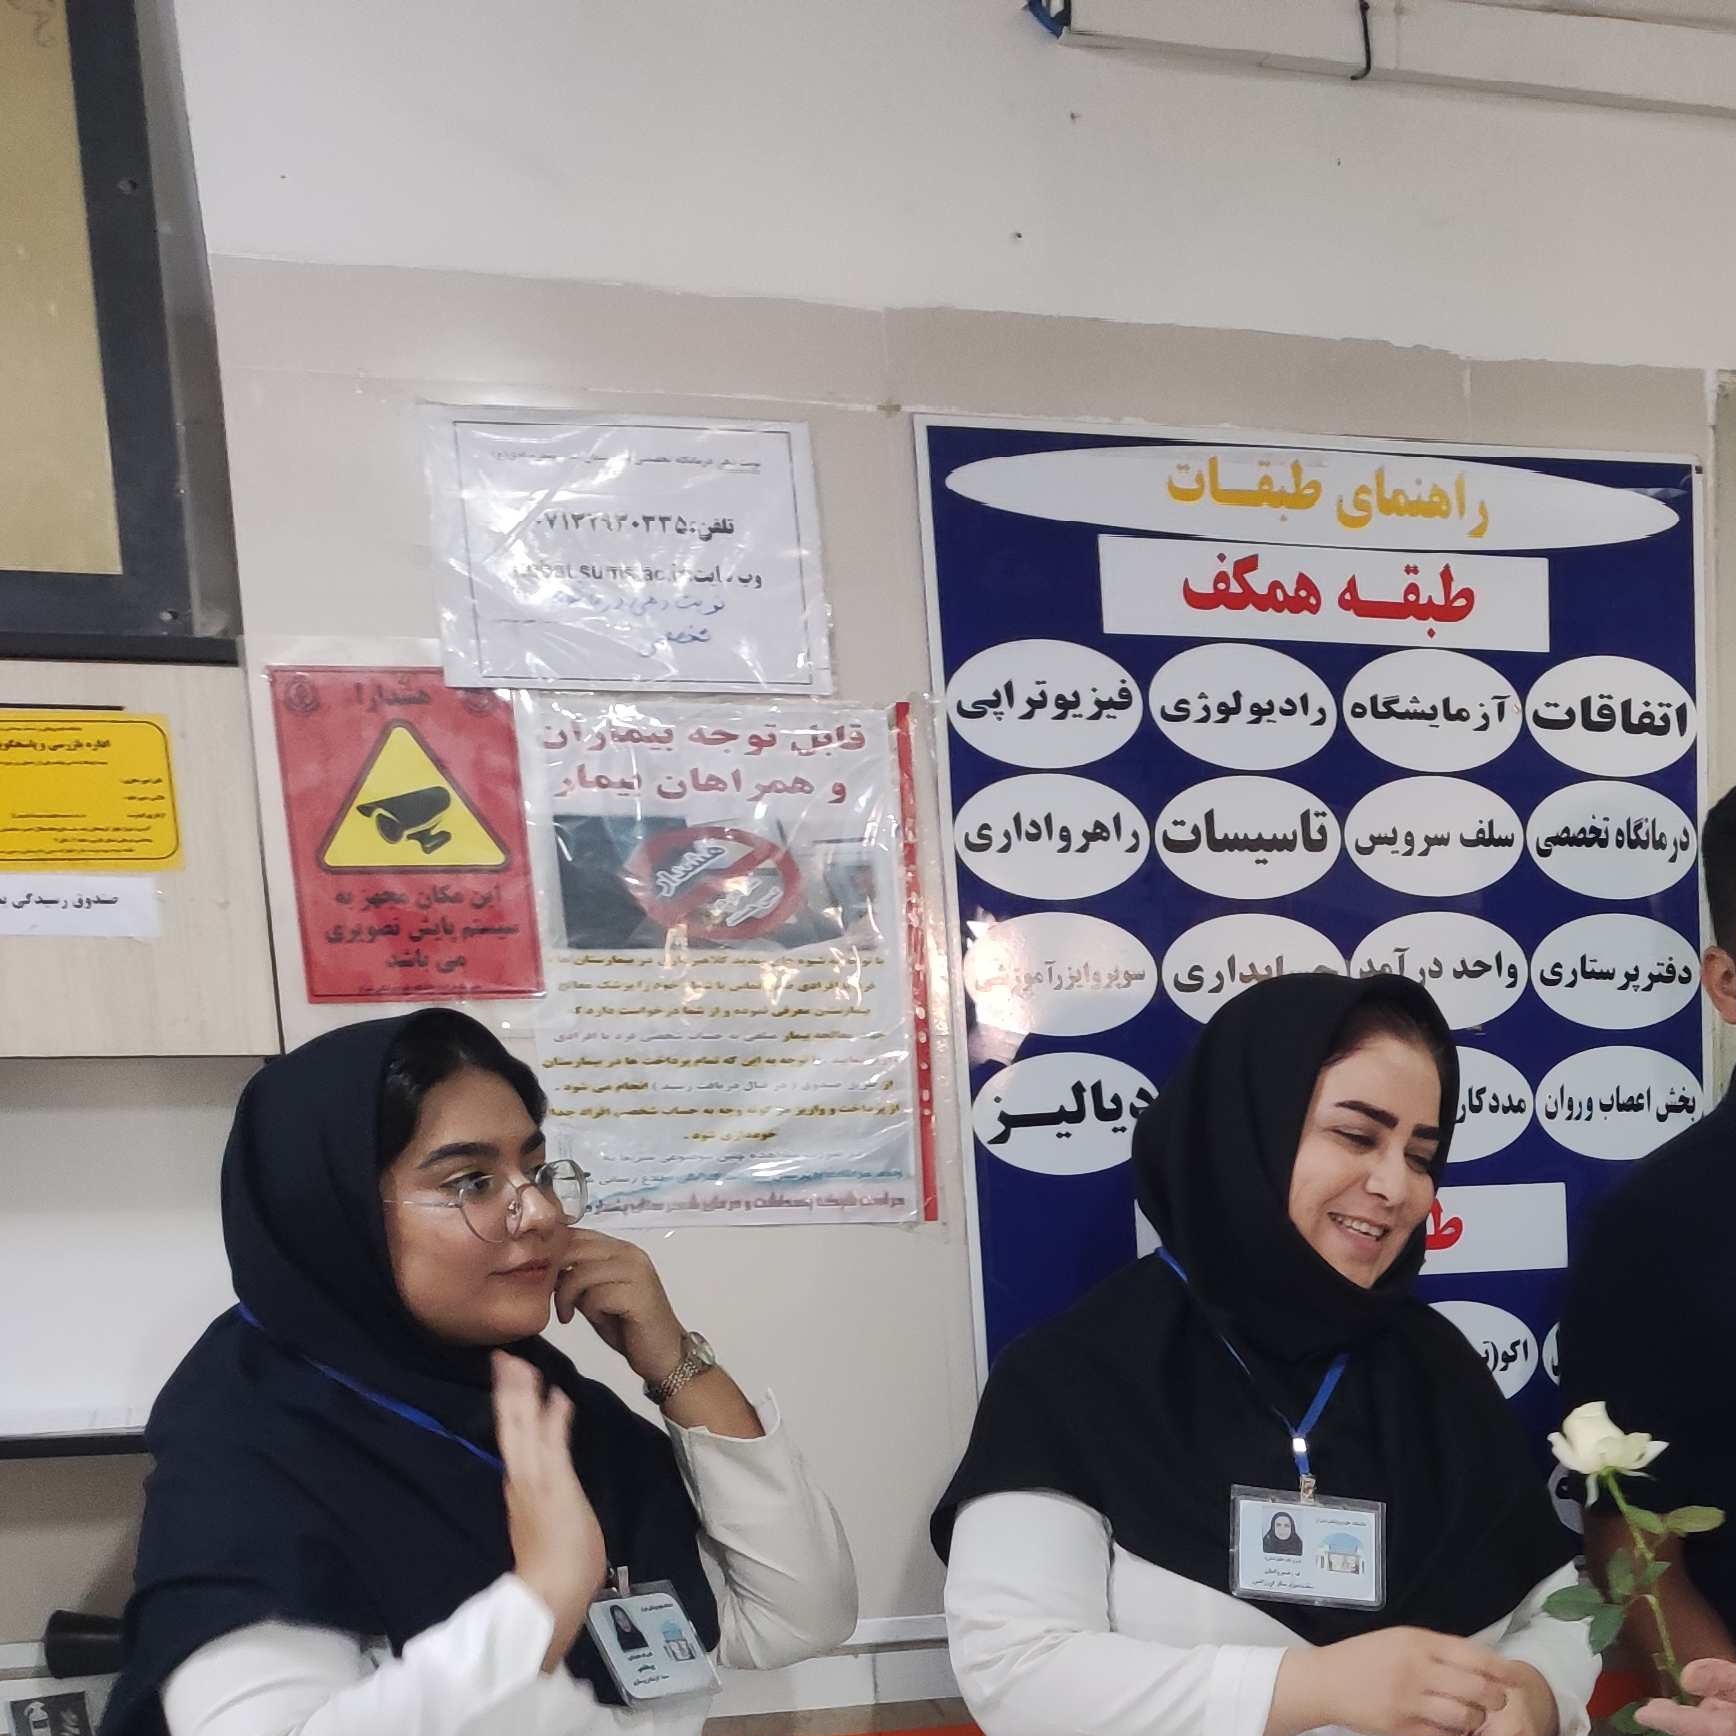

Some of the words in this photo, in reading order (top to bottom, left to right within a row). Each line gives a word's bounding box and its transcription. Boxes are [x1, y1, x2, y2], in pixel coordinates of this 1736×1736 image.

[1167, 455, 1323, 522] طبقات
[1336, 466, 1489, 538] راهنمای
[1182, 552, 1323, 616] همکف
[1336, 562, 1475, 639] طبقه
[956, 678, 1134, 721] فیزیوتراپی
[1159, 688, 1328, 726] رادیولوژی
[1349, 694, 1512, 732] آزمایشگاه
[1531, 693, 1688, 737] اتفاقات
[543, 720, 675, 751] بیماران
[688, 724, 778, 755] توجه
[789, 724, 867, 757] قابل
[554, 763, 642, 797] بیمار
[827, 781, 848, 804] و
[1161, 807, 1328, 865] تاسیسات
[1353, 824, 1451, 857] سرویس
[1459, 818, 1515, 849] سلف
[1535, 813, 1610, 858] تخصصی
[1616, 816, 1690, 864] درمانگاه
[1452, 950, 1519, 989] واحد
[986, 1078, 1155, 1145] دیالیز
[1599, 1084, 1651, 1121] اعصاب
[1656, 1086, 1697, 1123] بخش
